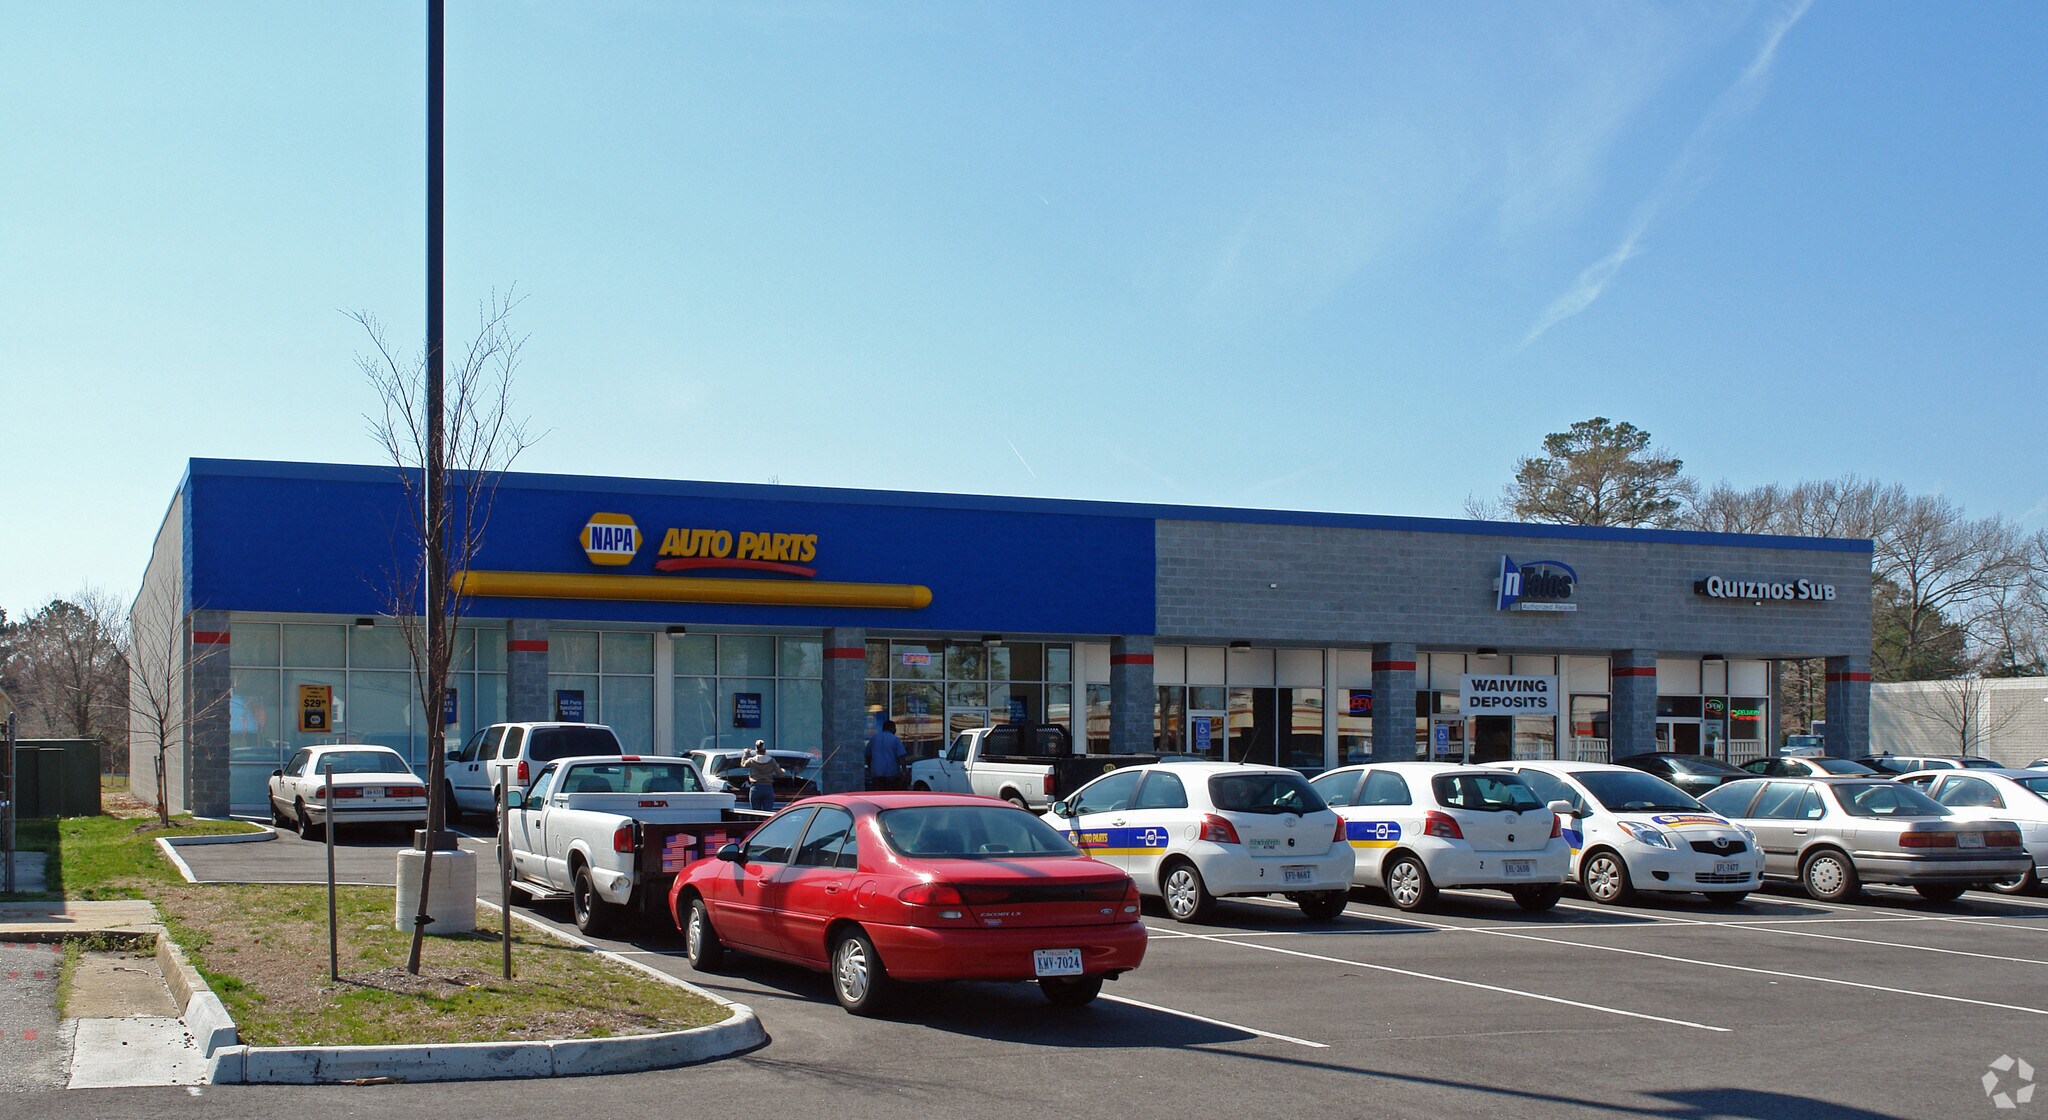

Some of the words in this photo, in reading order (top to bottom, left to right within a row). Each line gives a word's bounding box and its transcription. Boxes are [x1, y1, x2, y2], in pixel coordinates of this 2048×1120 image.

[591, 526, 634, 552] NAPA
[658, 528, 733, 558] AUTO
[737, 531, 818, 562] PARTS
[1522, 603, 1554, 611] Authorized
[1555, 603, 1577, 611] Retailer
[904, 654, 930, 664] OPEN
[1471, 679, 1548, 692] WAIVING
[1347, 696, 1373, 709] OPEN
[1469, 696, 1548, 708] DEPOSITS
[1705, 702, 1722, 710] OPEN
[1079, 833, 1093, 843] AUTO
[1093, 832, 1108, 842] PARTS
[1479, 861, 1484, 869] 2
[1037, 955, 1080, 969] KMV-7024
